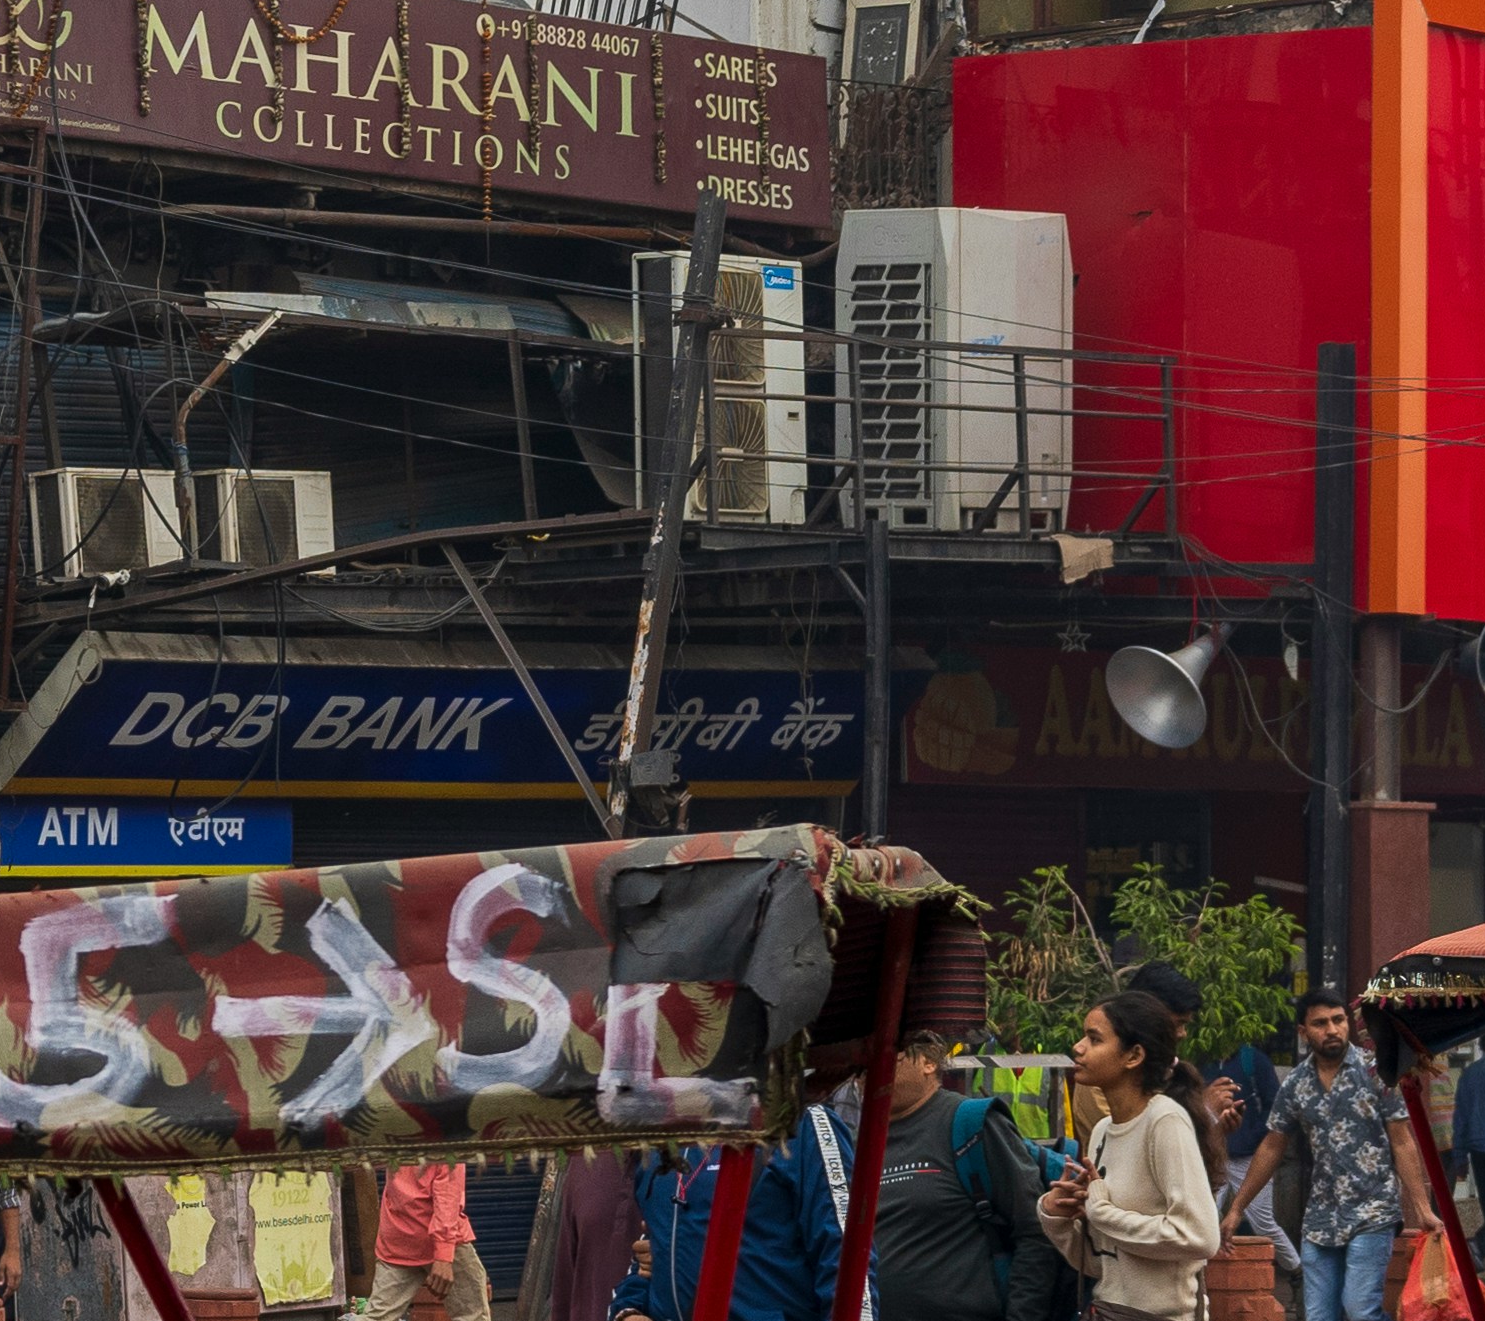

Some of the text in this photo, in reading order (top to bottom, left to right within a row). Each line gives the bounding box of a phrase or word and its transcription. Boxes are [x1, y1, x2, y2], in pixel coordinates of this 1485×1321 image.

[537, 23, 587, 50] 88828
[591, 33, 640, 58] 44067
[145, 3, 640, 138] MAHARANI
[705, 93, 761, 126] SUITS
[216, 100, 571, 180] COLLECTIONS
[109, 692, 513, 751] DCB BANK
[770, 696, 855, 751] बैंक
[38, 806, 118, 847] ATM
[168, 811, 246, 847] एटीएम
[180, 1201, 201, 1210] Power
[271, 1189, 311, 1207] 19122
